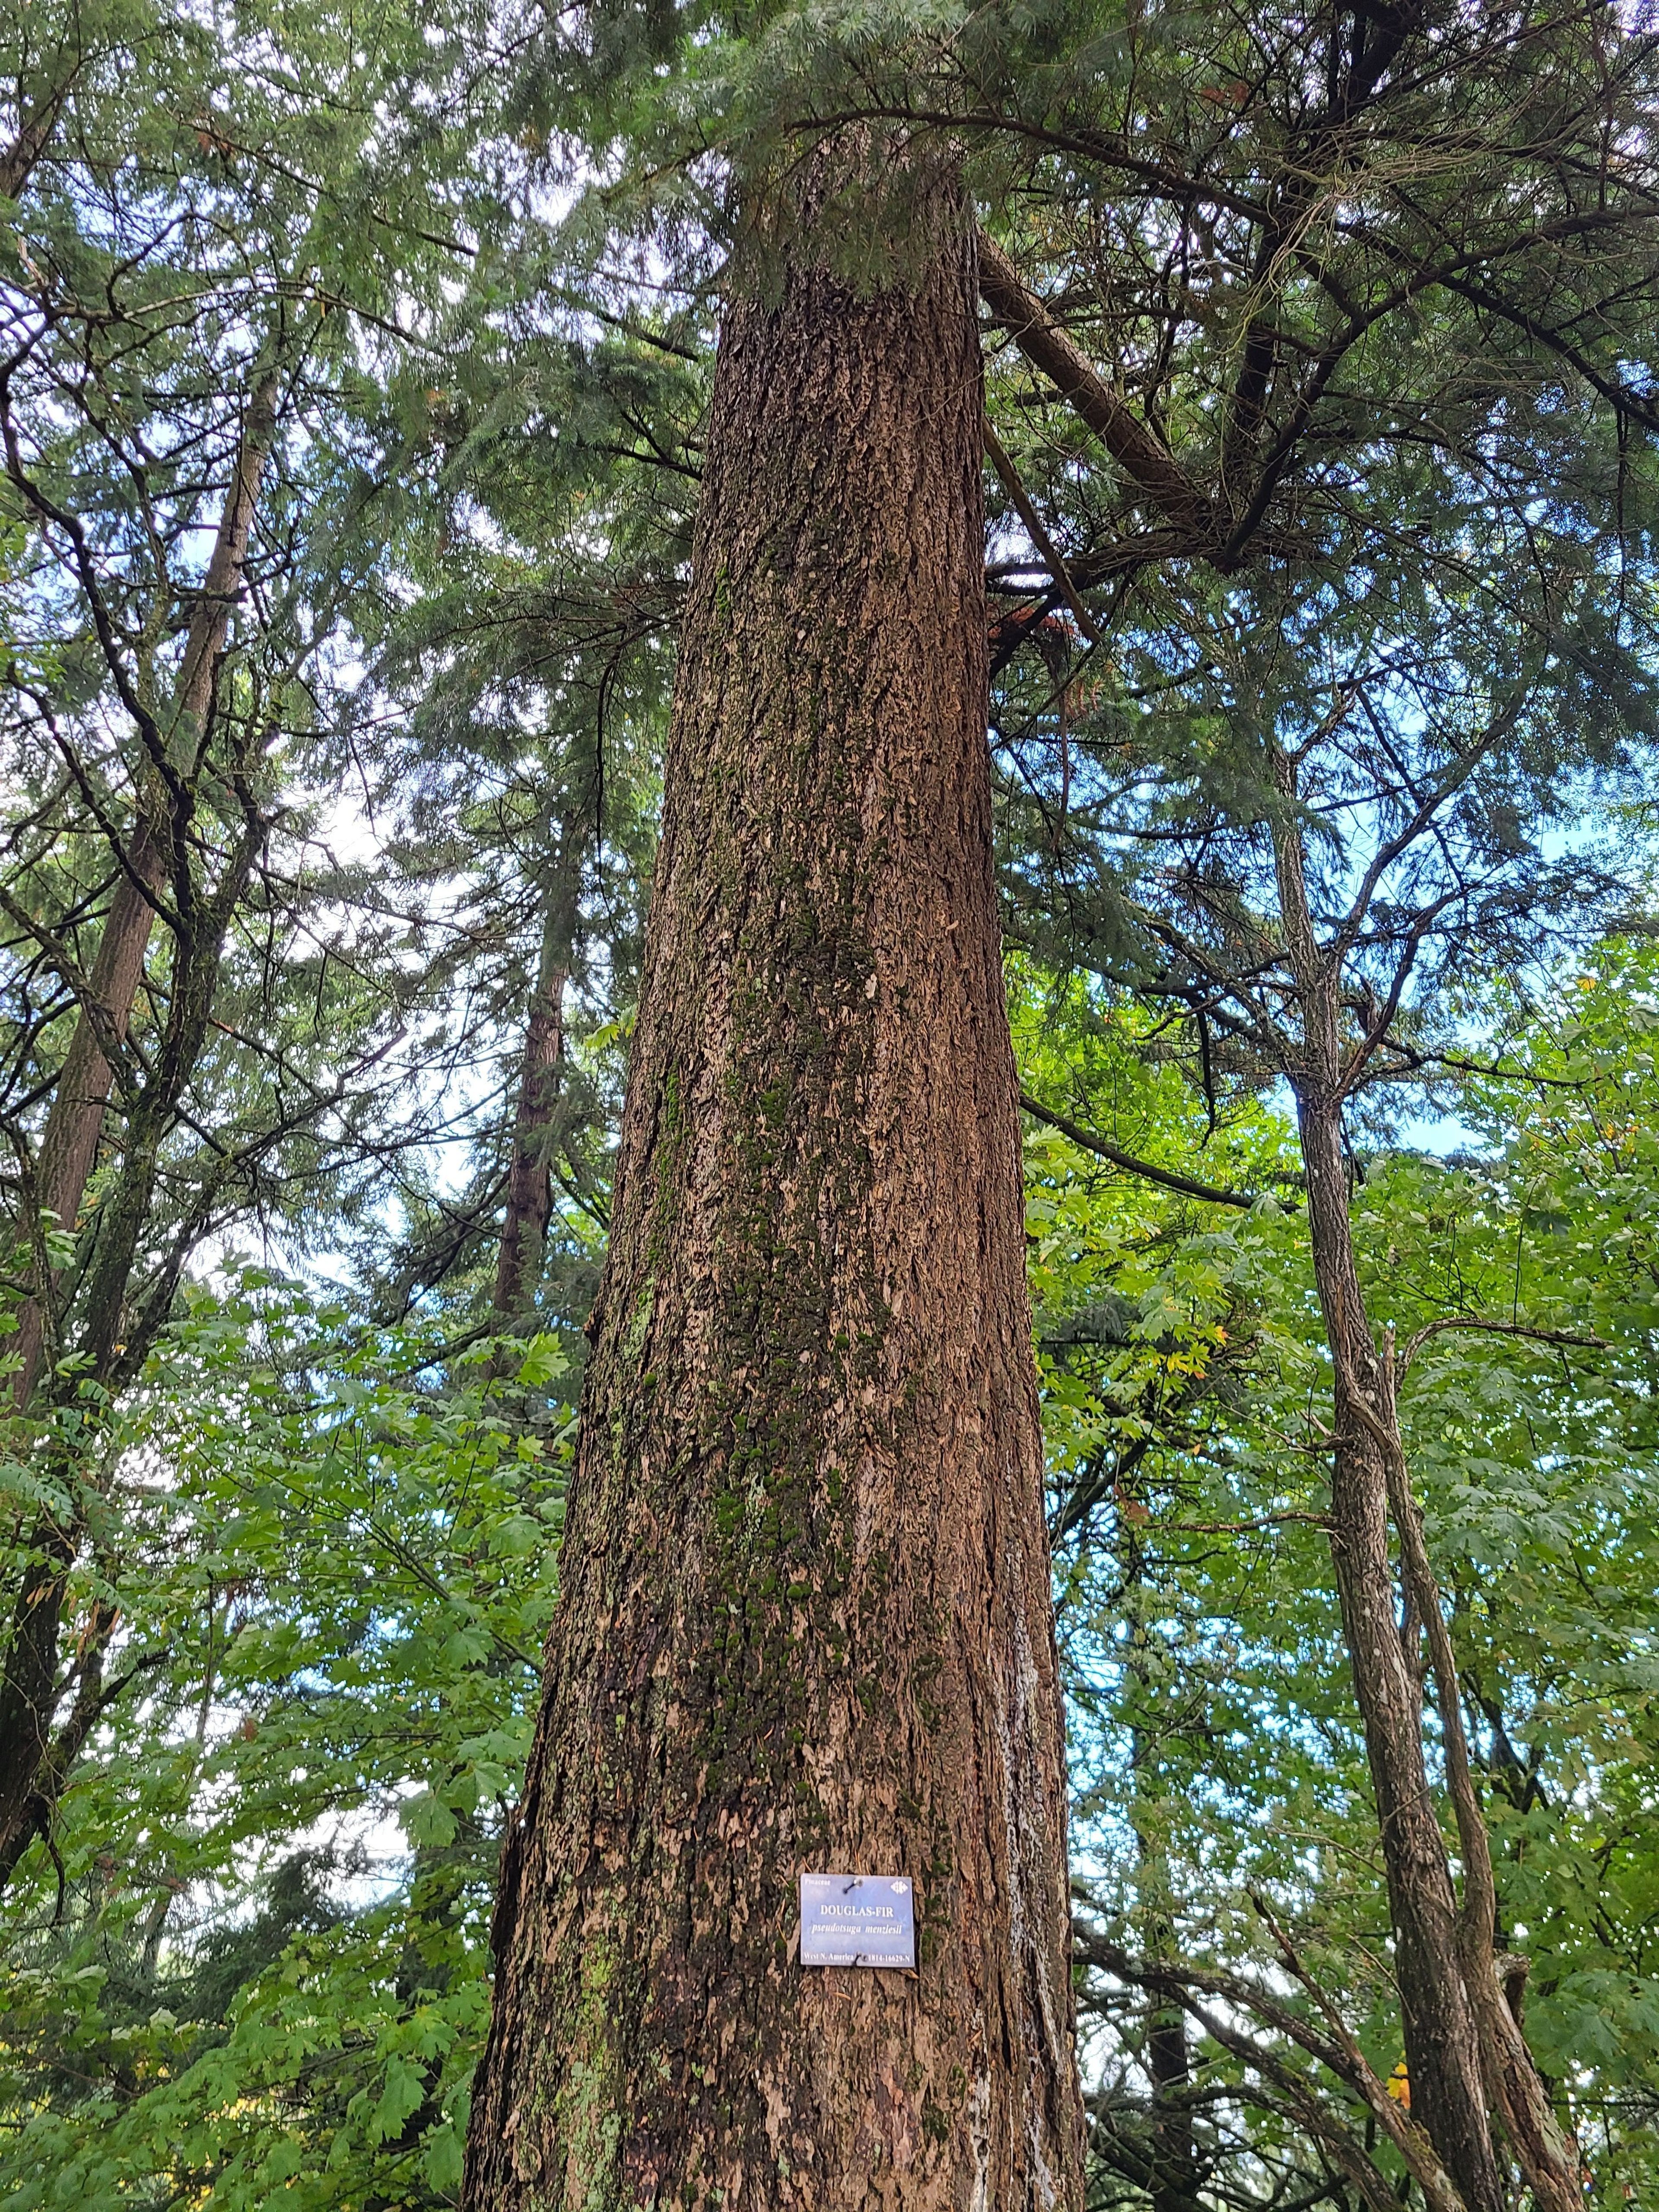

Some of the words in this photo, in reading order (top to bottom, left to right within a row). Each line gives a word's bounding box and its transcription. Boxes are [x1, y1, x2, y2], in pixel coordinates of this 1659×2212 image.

[820, 1905, 893, 1917] DOUGLAS-FIR
[811, 1923, 861, 1934] pseudotsuga
[865, 1925, 902, 1934] menziesii
